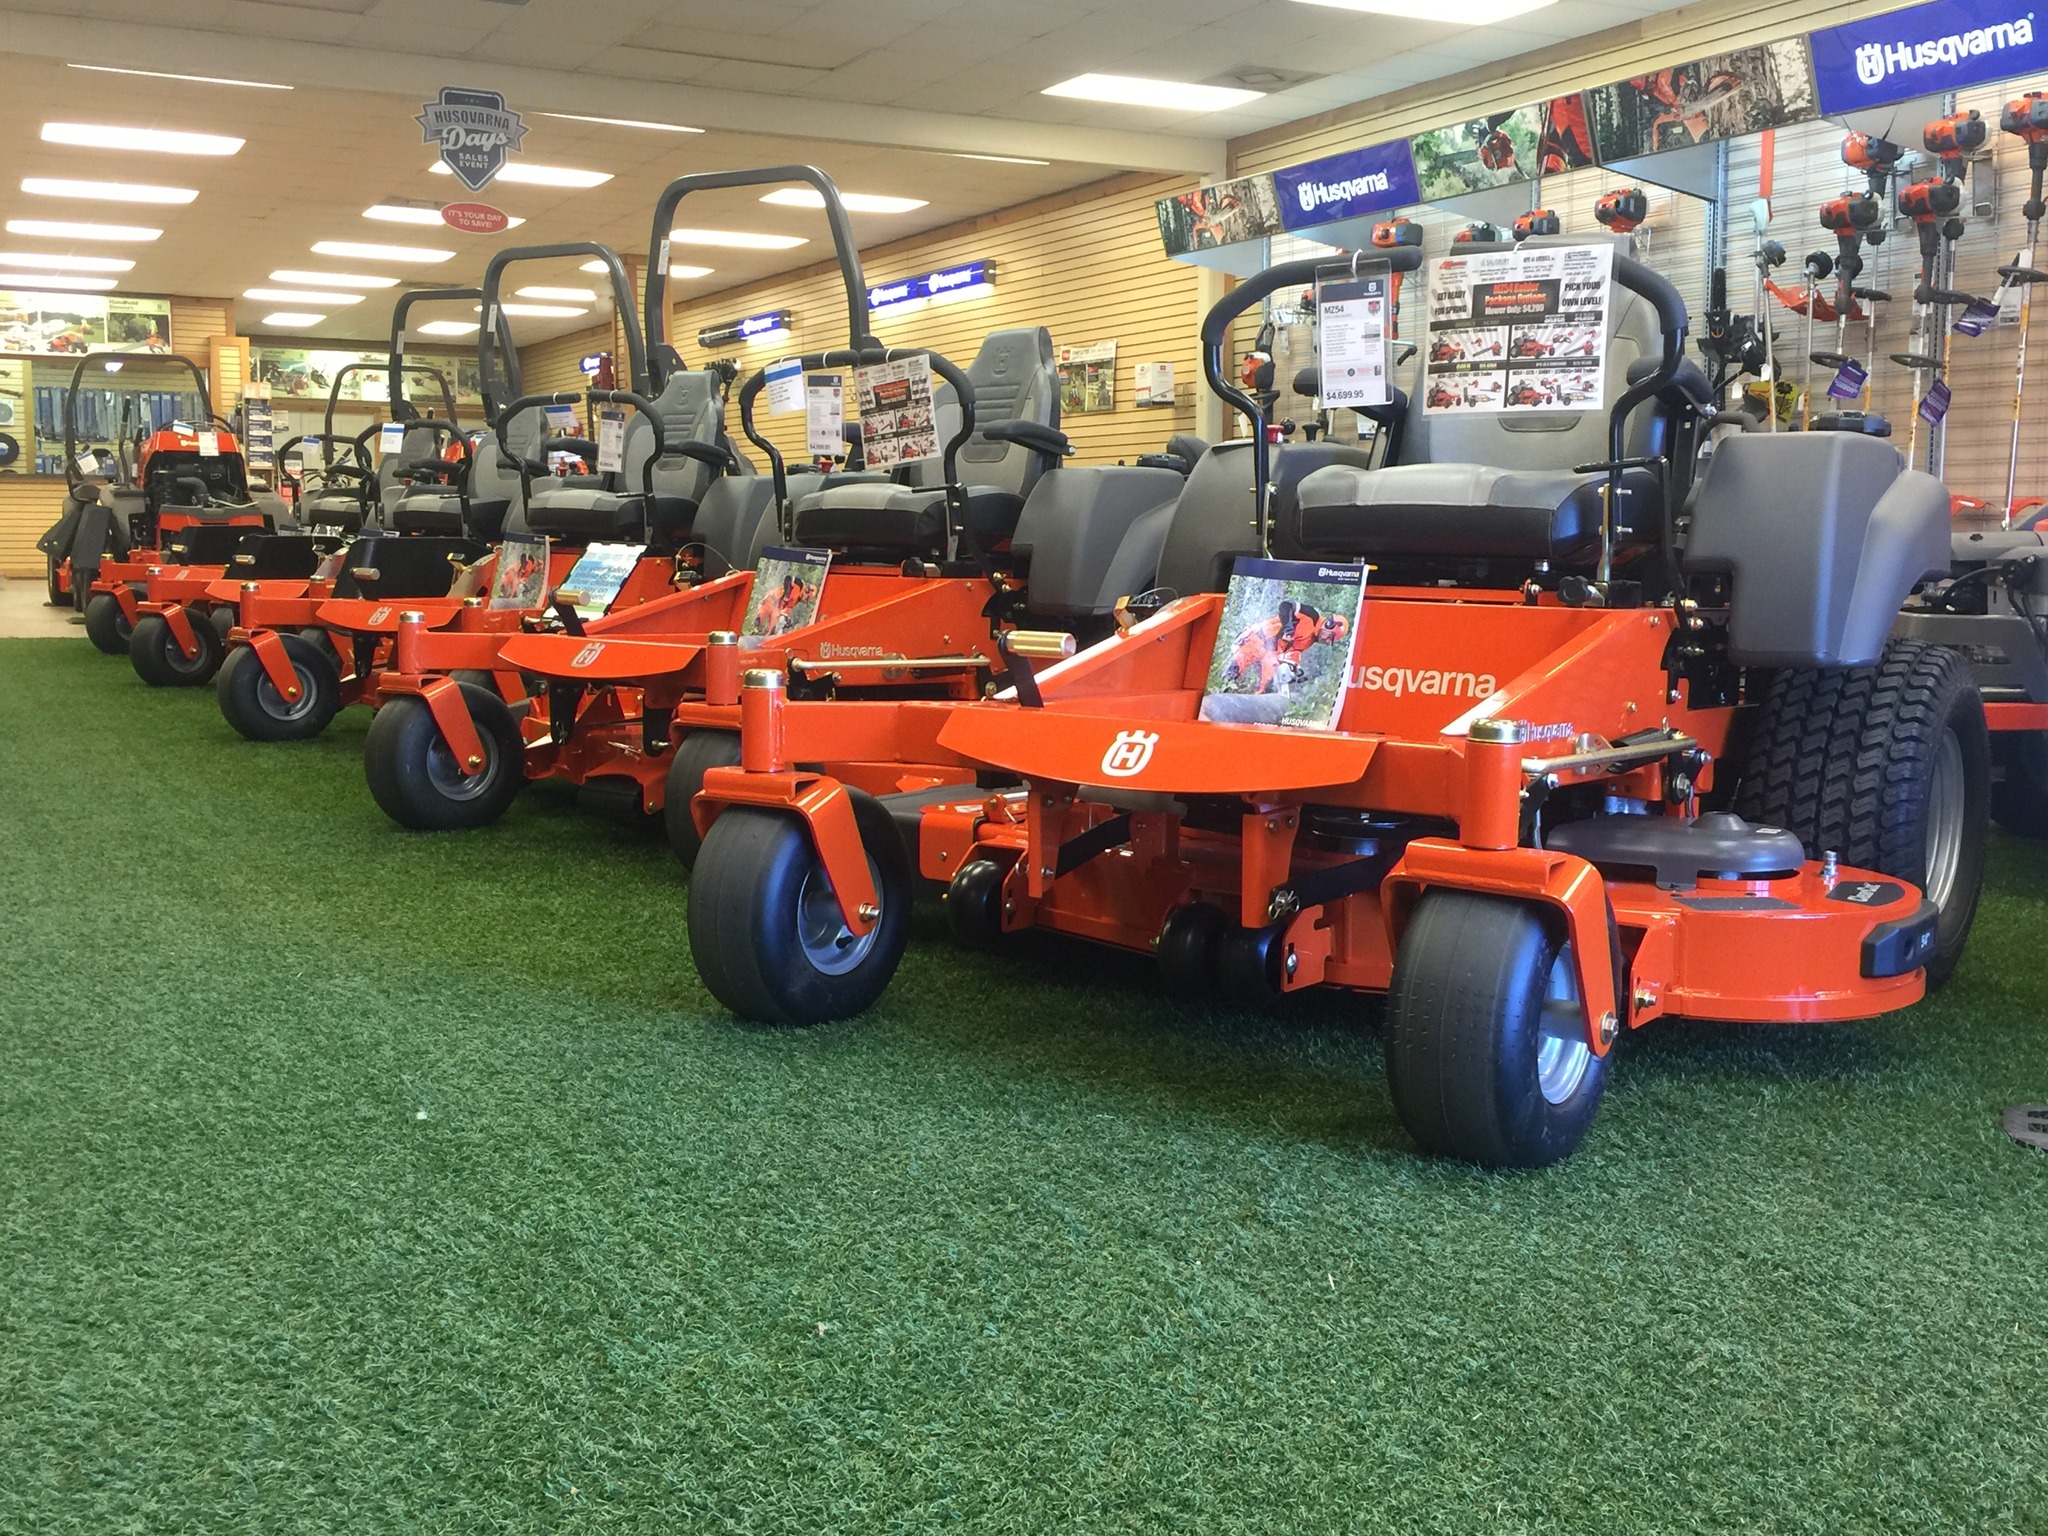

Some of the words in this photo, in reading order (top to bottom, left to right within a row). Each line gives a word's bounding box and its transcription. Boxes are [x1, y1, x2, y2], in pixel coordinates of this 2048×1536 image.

[1884, 18, 2034, 74] Husqvarna
[434, 110, 510, 130] HUSQVARNA
[441, 125, 508, 152] Days
[458, 152, 489, 162] SALES
[460, 161, 489, 169] EVENT
[1313, 172, 1389, 205] Husqvarna
[448, 209, 462, 218] IT'S
[464, 211, 486, 221] YOUR
[487, 213, 502, 222] DAY
[460, 218, 470, 226] TO
[1564, 282, 1581, 291] PICK
[1582, 281, 1601, 290] YOUR
[1562, 298, 1579, 306] OWN
[1324, 305, 1345, 315] MZ54
[1445, 305, 1467, 315] SPRING
[1326, 390, 1364, 401] $4,699.95
[608, 566, 628, 574] safety
[1326, 569, 1360, 578] Husqvarna
[831, 645, 883, 658] Husqvarna
[1347, 665, 1497, 699] usqvarna
